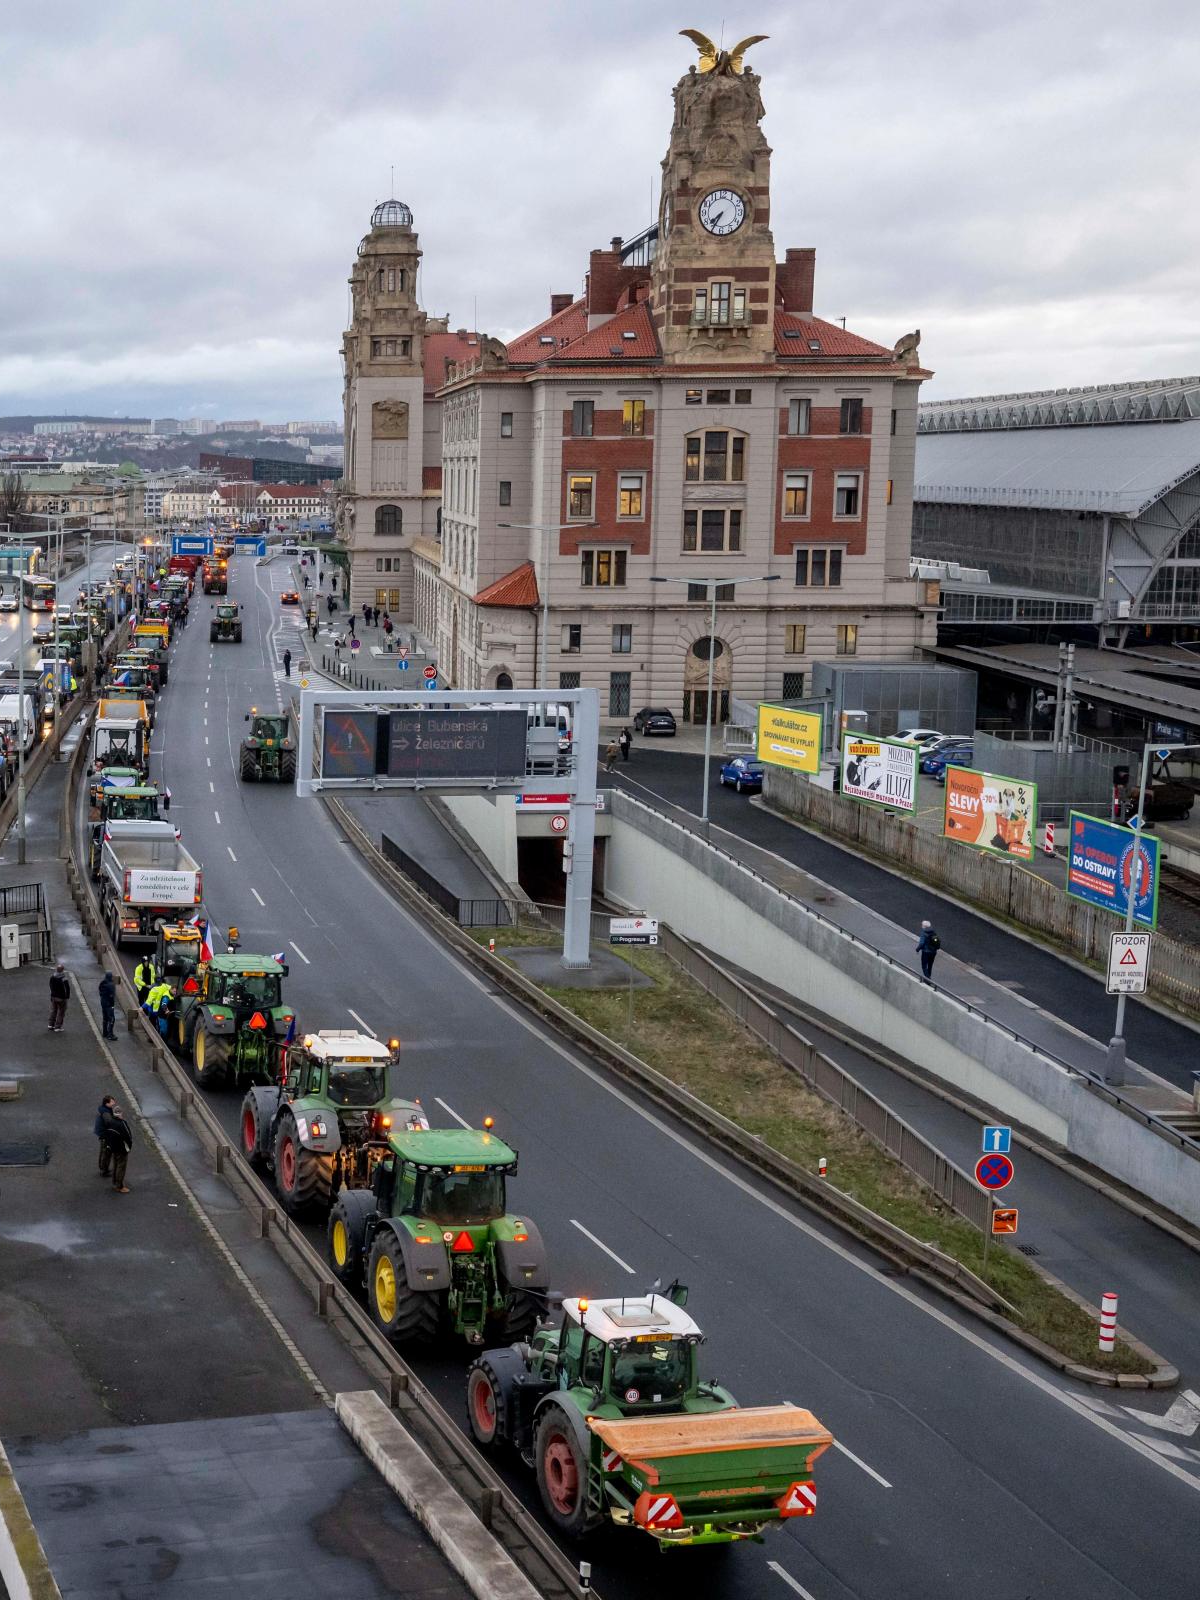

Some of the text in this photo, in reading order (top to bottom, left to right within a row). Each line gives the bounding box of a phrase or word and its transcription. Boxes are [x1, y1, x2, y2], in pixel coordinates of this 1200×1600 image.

[720, 191, 727, 199] 12
[702, 209, 706, 217] 9
[738, 209, 742, 217] 3
[392, 718, 488, 732] ulice Bubenská
[850, 745, 872, 754] VODIČKOVA
[888, 746, 912, 764] MUZEUM
[886, 774, 912, 799] ILUZÍ
[950, 780, 978, 794] Novoroční
[876, 793, 894, 804] muzeum
[899, 798, 912, 808] Praze
[950, 792, 980, 812] SLEVY
[1086, 846, 1118, 866] OPEROU
[1073, 855, 1116, 880] DO OSTRAVY
[1115, 936, 1146, 946] POZOR
